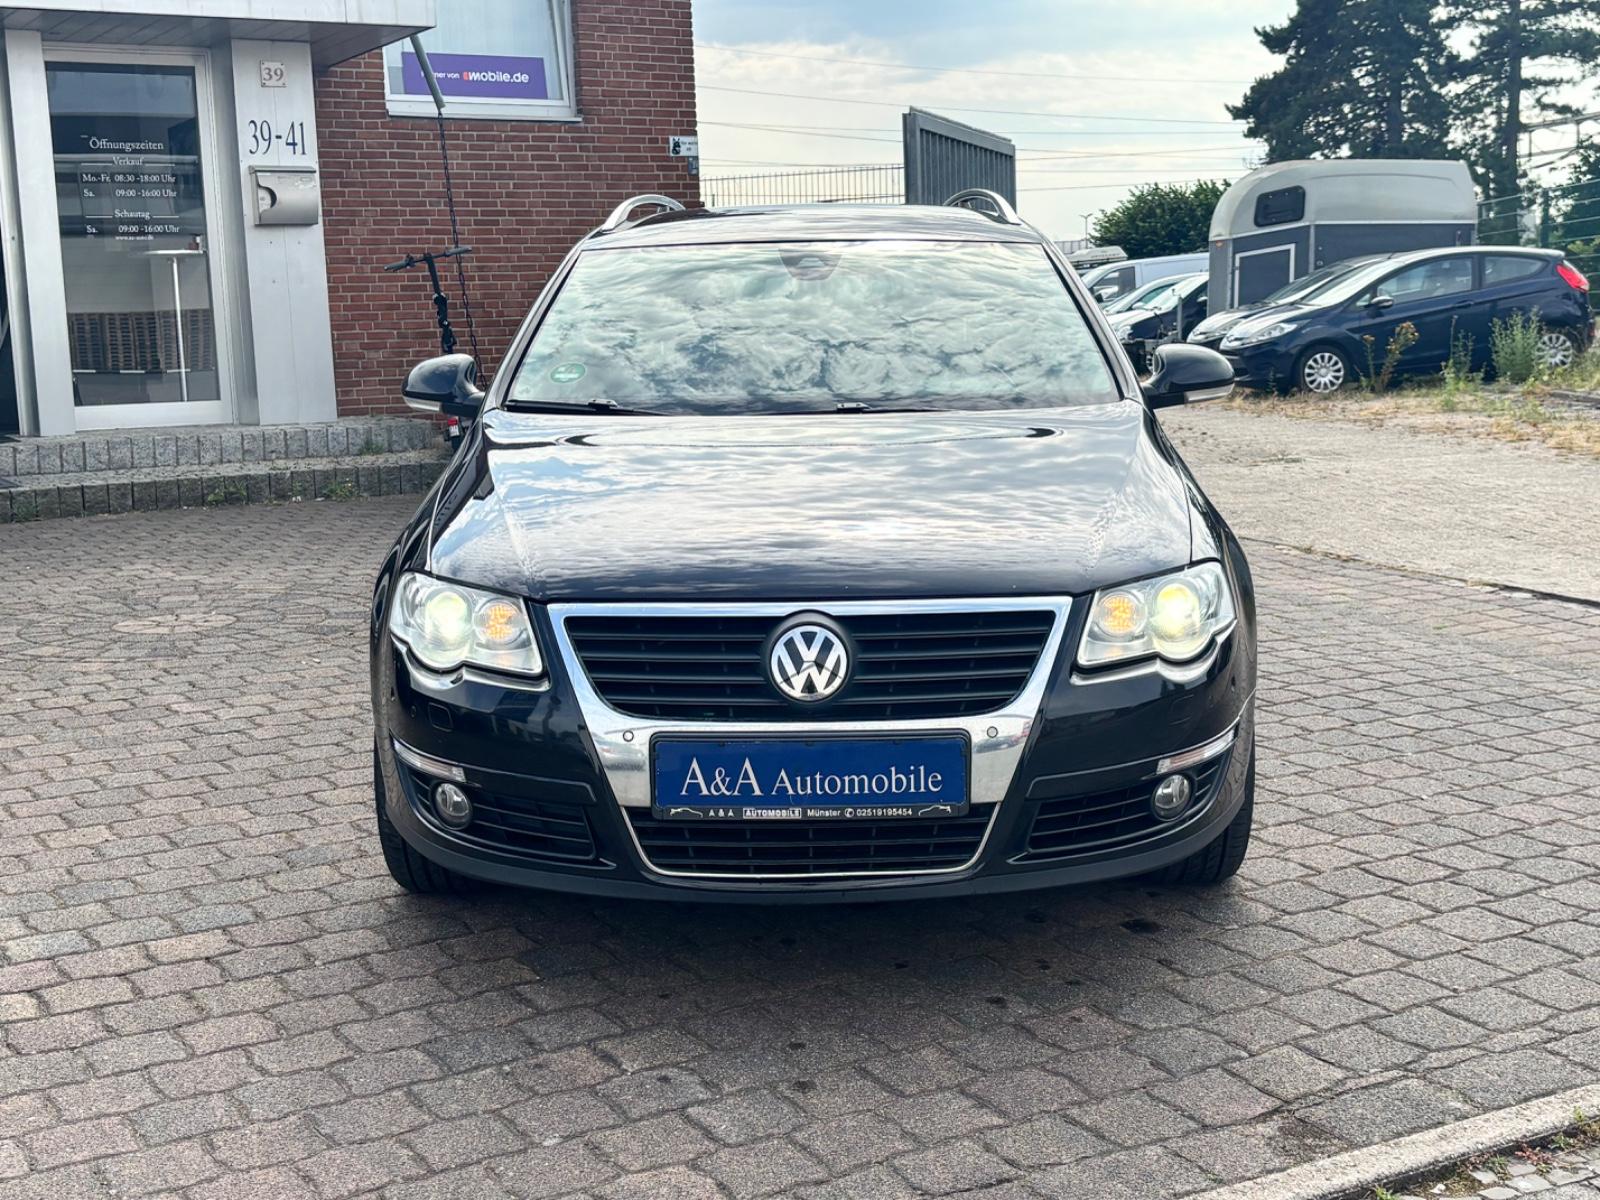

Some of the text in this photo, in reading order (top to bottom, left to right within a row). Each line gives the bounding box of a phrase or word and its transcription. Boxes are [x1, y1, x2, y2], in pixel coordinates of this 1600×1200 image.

[263, 67, 284, 82] 39
[468, 71, 529, 83] mobile.de
[89, 136, 164, 152] Öffnungszeiten
[112, 156, 144, 166] Verkauf
[114, 174, 135, 182] 08:30
[161, 174, 176, 183] Uhr
[83, 188, 95, 197] Sa.
[115, 189, 136, 197] 09:00
[162, 189, 177, 197] Uhr
[114, 209, 150, 220] Schautag
[86, 225, 98, 233] Sa.
[118, 225, 139, 233] 09:00
[165, 225, 180, 233] Uhr
[680, 757, 943, 796] A&A Automobile
[745, 808, 800, 817] AUTOMOBILE
[807, 808, 841, 817] Münster
